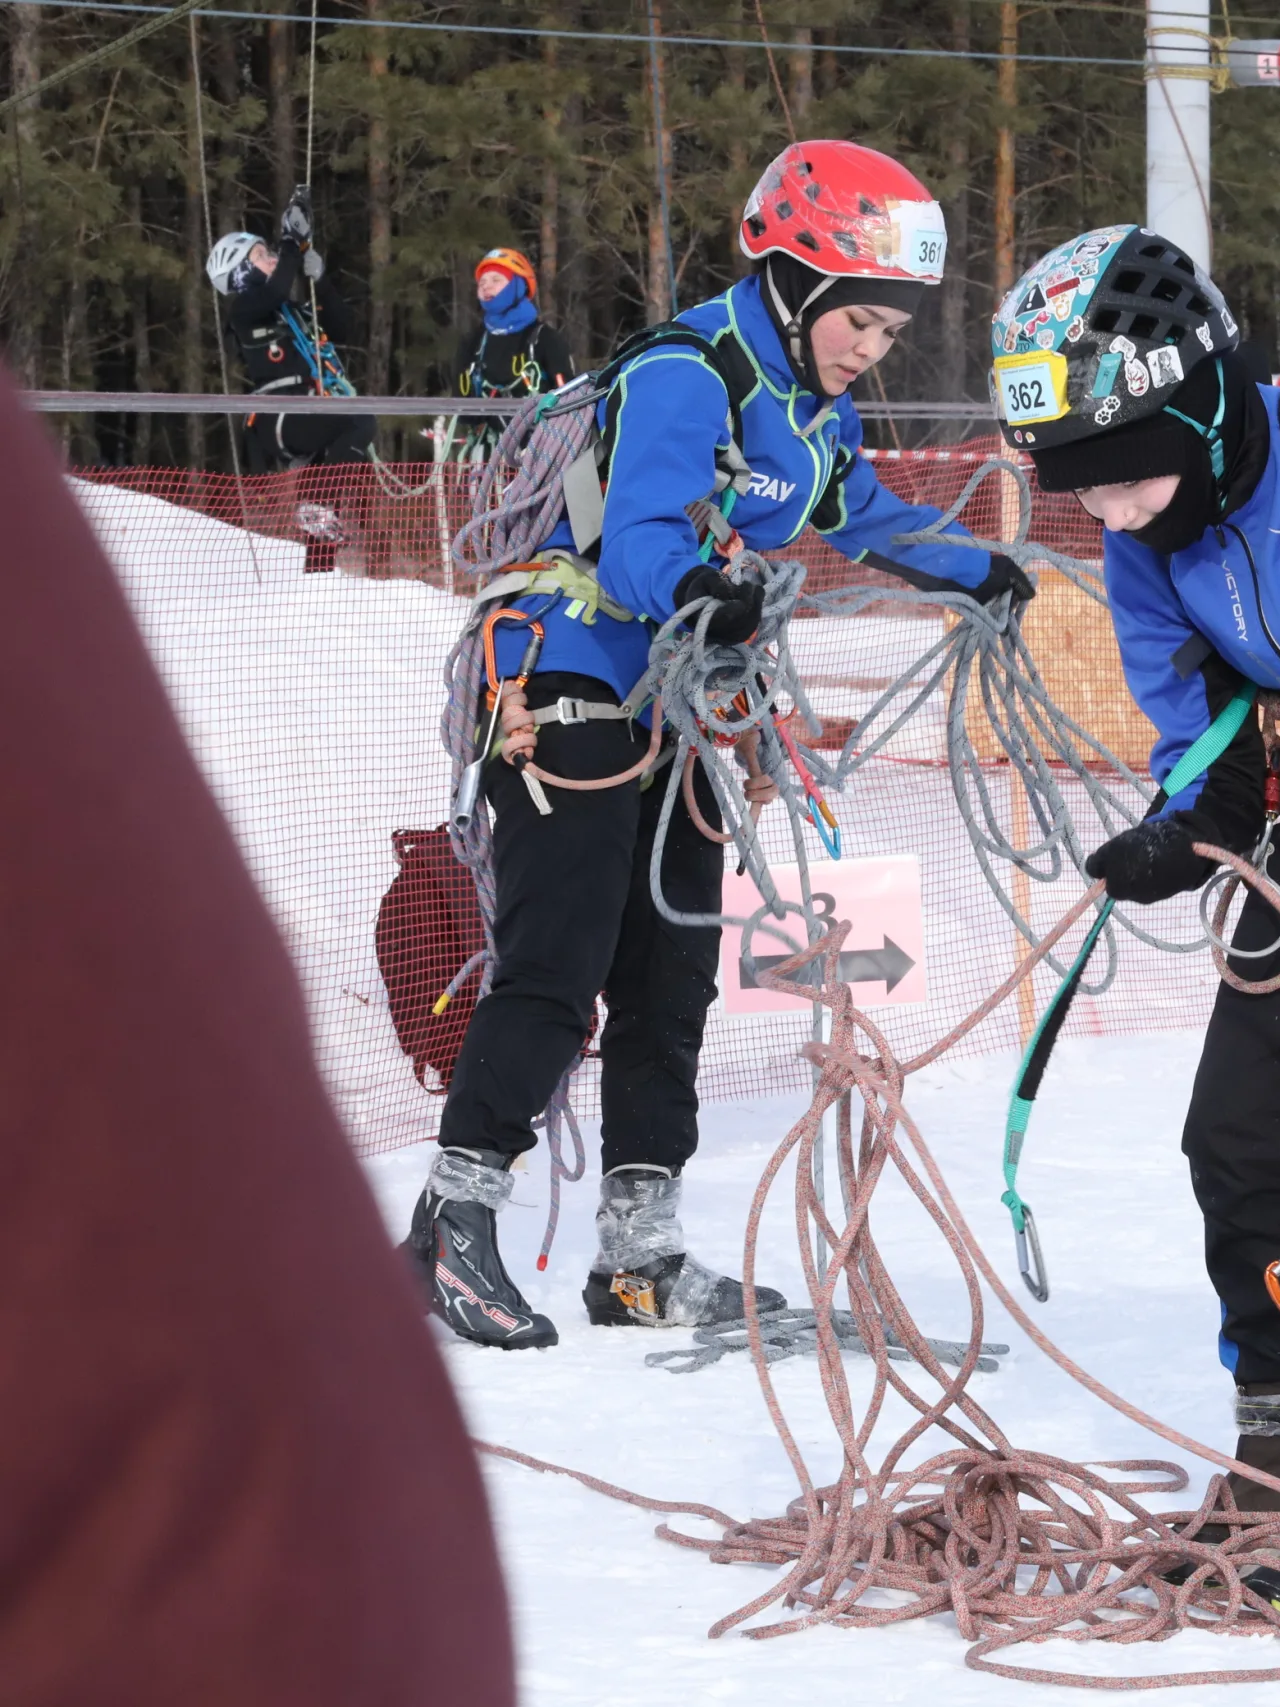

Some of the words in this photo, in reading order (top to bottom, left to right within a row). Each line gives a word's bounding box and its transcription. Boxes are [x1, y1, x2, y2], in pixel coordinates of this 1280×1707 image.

[1263, 57, 1273, 75] 1
[919, 241, 942, 263] 361
[1008, 380, 1046, 411] 362
[1222, 559, 1249, 642] VICTORY
[439, 1163, 501, 1191] SPINE
[435, 1261, 519, 1332] SPINE
